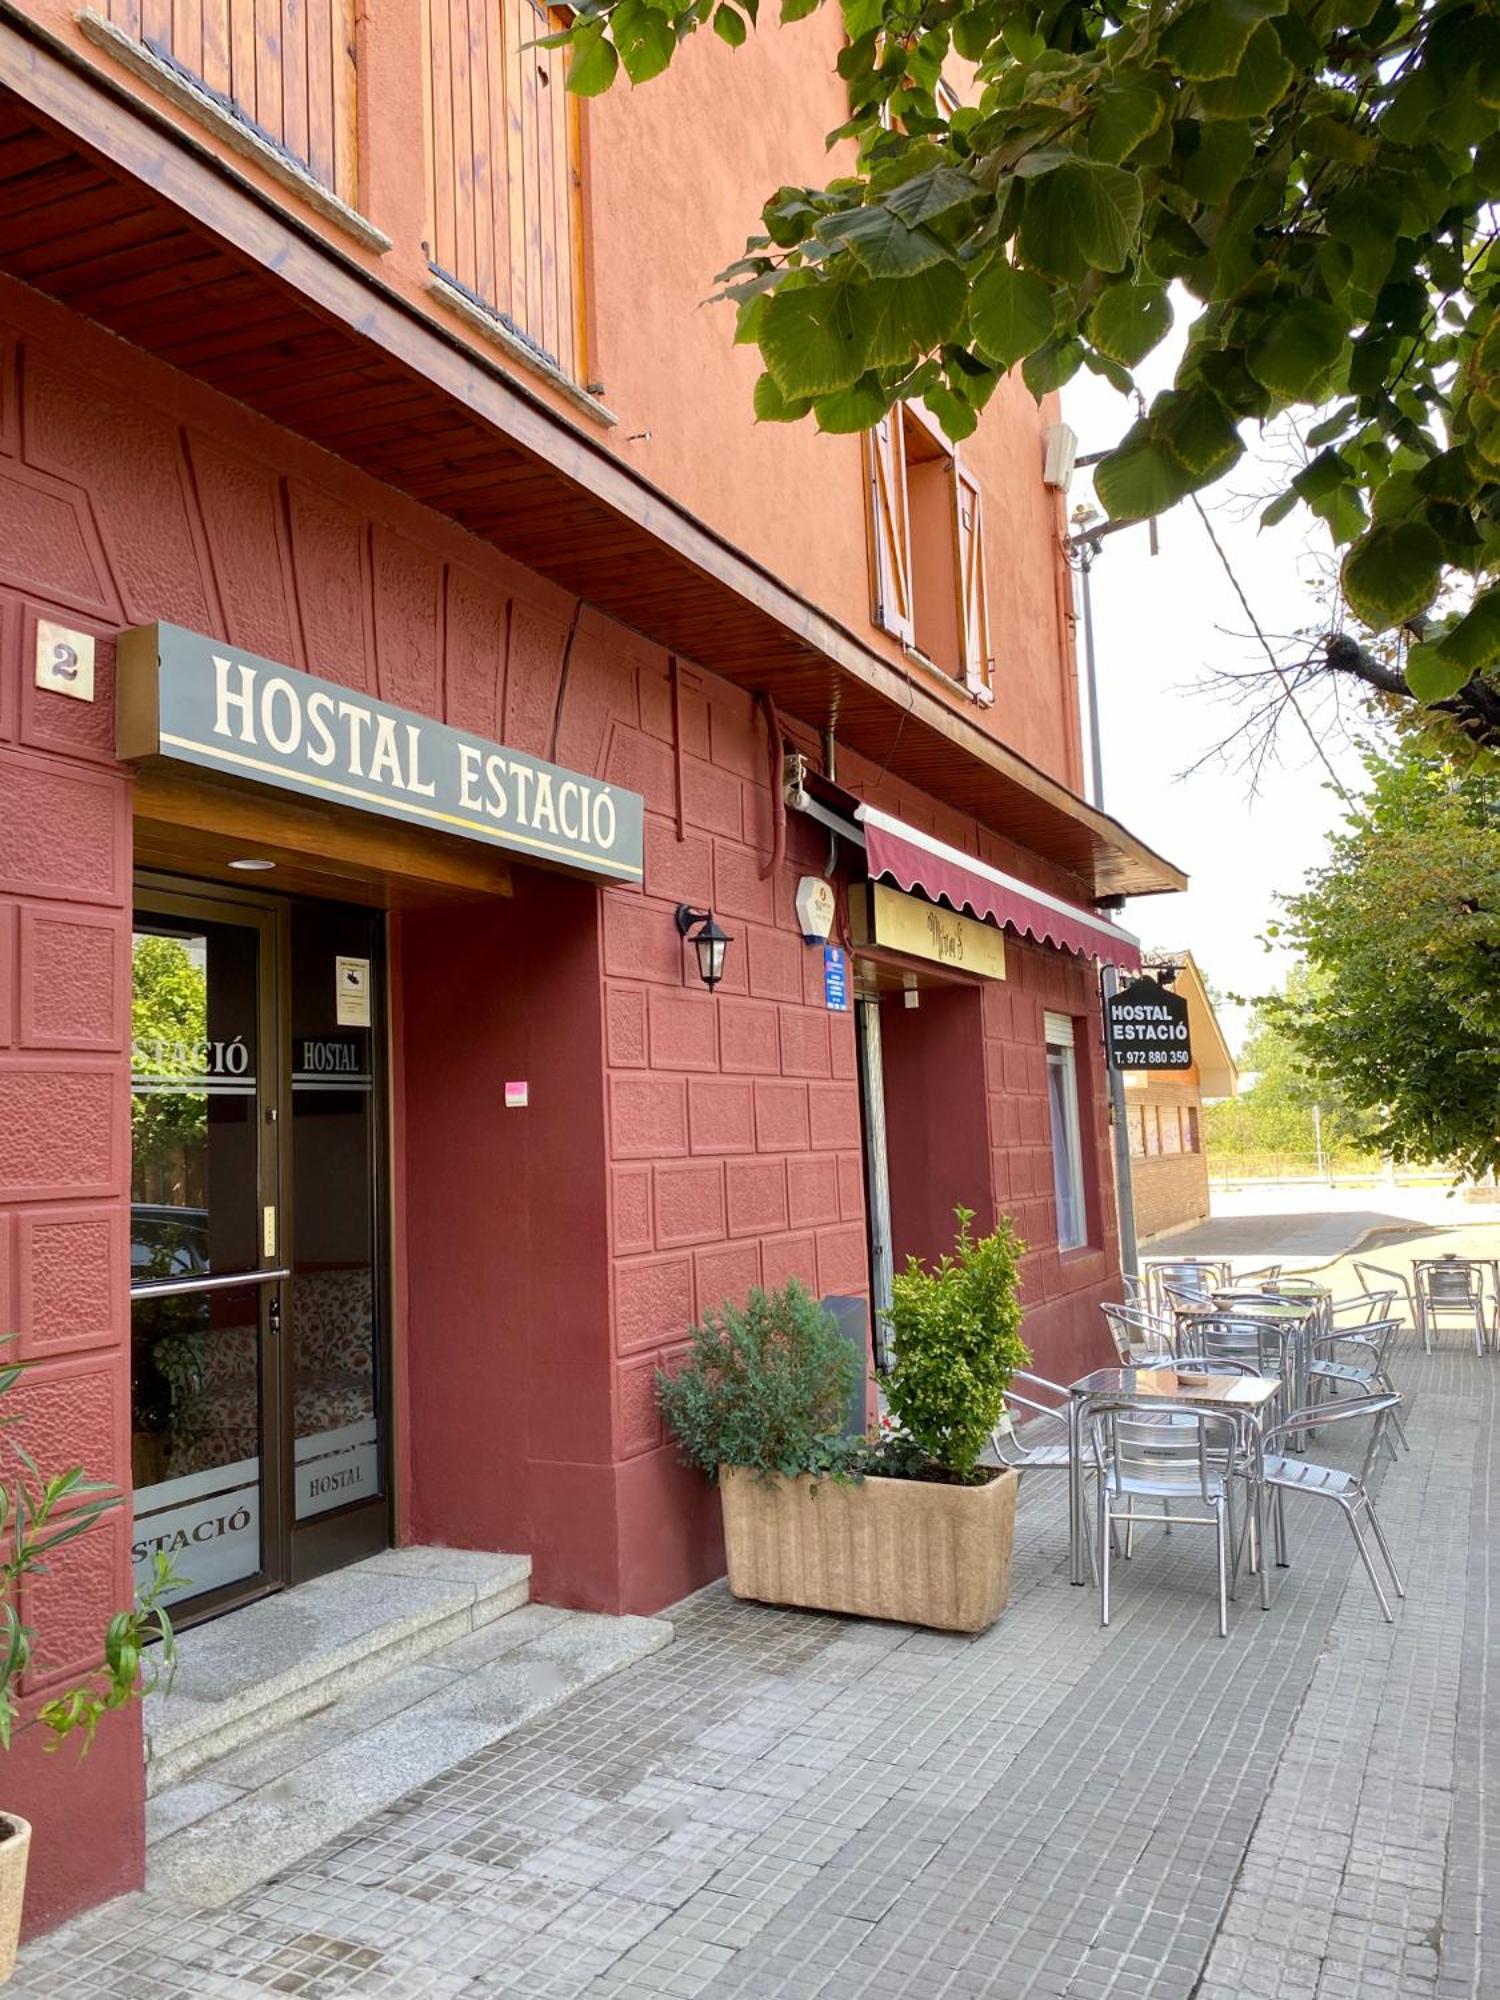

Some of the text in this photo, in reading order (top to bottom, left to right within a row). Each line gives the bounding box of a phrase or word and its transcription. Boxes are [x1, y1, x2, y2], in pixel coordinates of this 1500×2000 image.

[52, 643, 78, 681] 2
[212, 655, 616, 849] HOSTAL ESTACIÓ
[1111, 1005, 1173, 1021] HOSTAL
[1113, 1021, 1188, 1040] ESTACIÓ
[131, 1035, 249, 1074] STACIÓ
[303, 1041, 359, 1072] HOSTAL
[1114, 1050, 1189, 1064] T. 972 880 350
[309, 1465, 364, 1498] HOSTAL
[131, 1506, 251, 1564] STACIÓ
